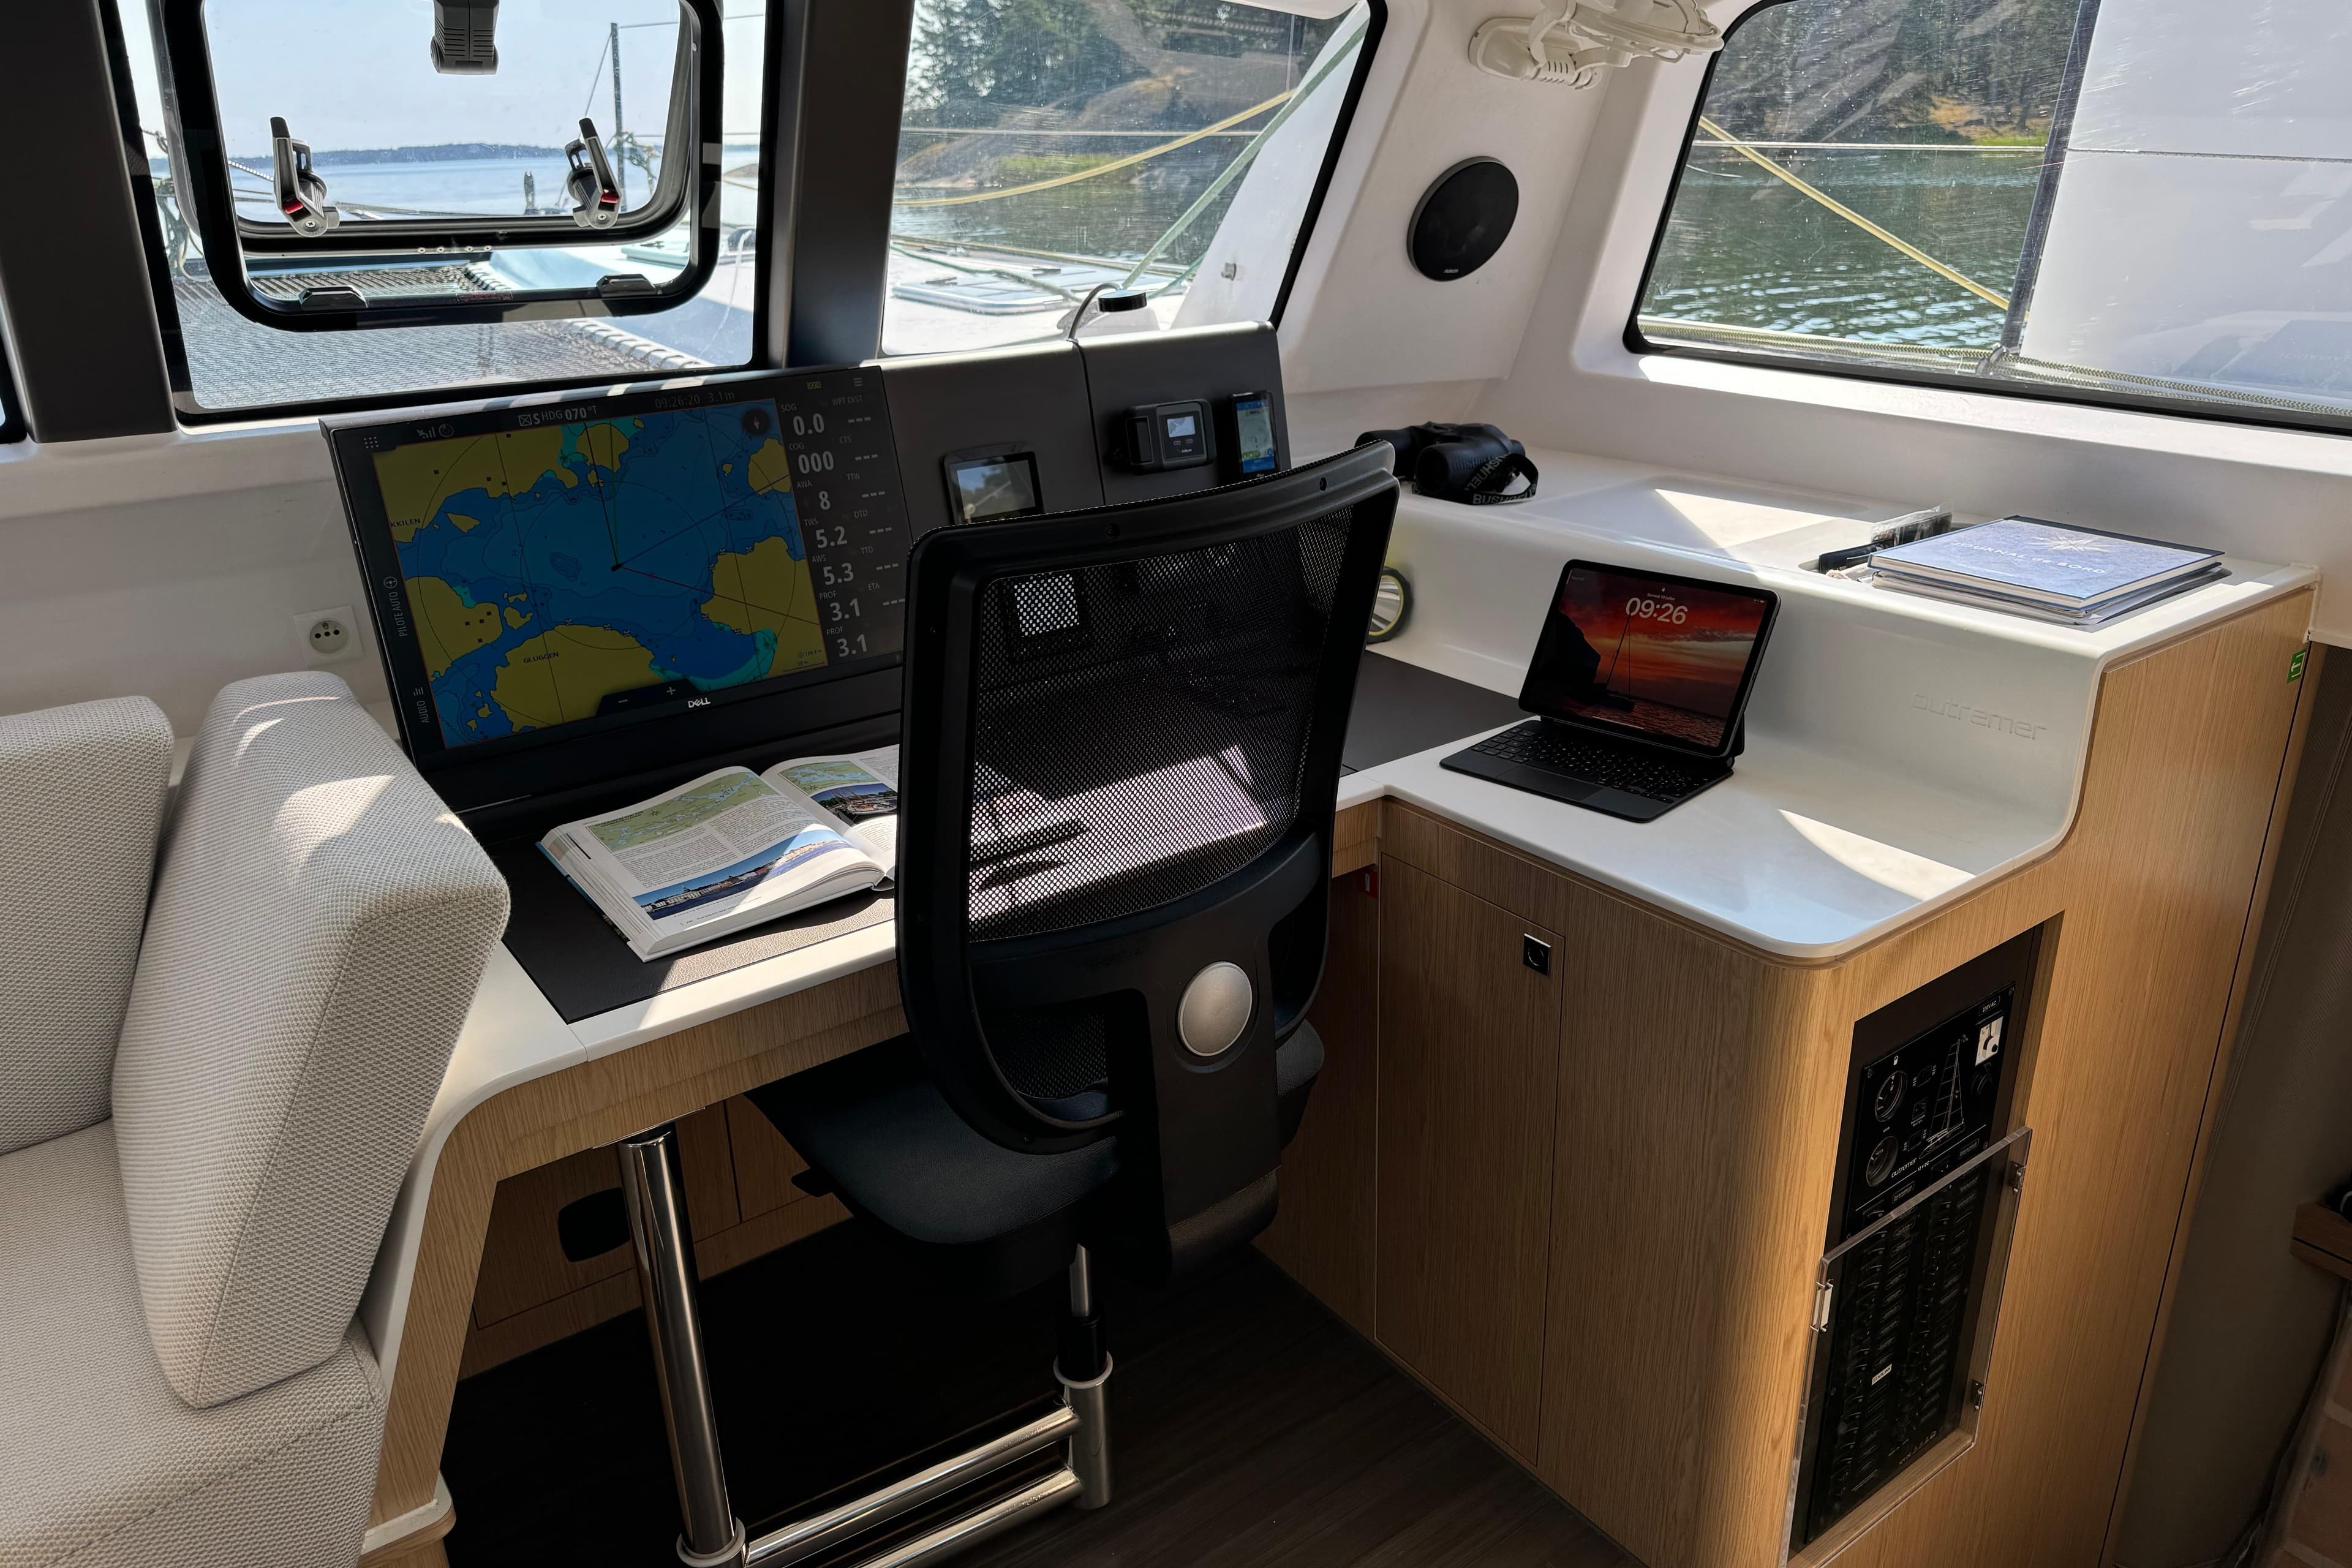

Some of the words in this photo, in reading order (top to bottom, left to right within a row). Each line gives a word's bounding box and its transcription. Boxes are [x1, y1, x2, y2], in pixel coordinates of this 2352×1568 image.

[780, 403, 797, 412] SOG
[832, 397, 845, 407] WPT
[846, 395, 862, 404] DIST
[541, 410, 563, 421] HDG
[564, 407, 587, 420] 070
[793, 413, 825, 436] 0.0
[788, 442, 805, 451] COG
[839, 435, 852, 445] CTS
[798, 451, 834, 475] 000
[846, 472, 860, 481] TTW
[796, 480, 813, 489] AWA
[818, 490, 831, 510] 8
[853, 509, 868, 519] DTD
[803, 518, 819, 527] TWS
[815, 526, 848, 549] 5.2
[812, 554, 827, 564] AWS
[1951, 541, 2026, 559] JOURNAL
[2056, 562, 2106, 573] BORD
[823, 562, 854, 586] 5.3
[867, 582, 881, 592] ETA
[389, 592, 402, 611] AUTO
[818, 590, 837, 601] PROF
[829, 598, 861, 622] 3.1
[1625, 597, 1689, 625] 09:26
[393, 612, 409, 638] PILOTE
[826, 626, 844, 636] PROF
[837, 633, 868, 657] 3.1
[687, 697, 711, 709] DELL
[417, 700, 431, 723] AUDIO
